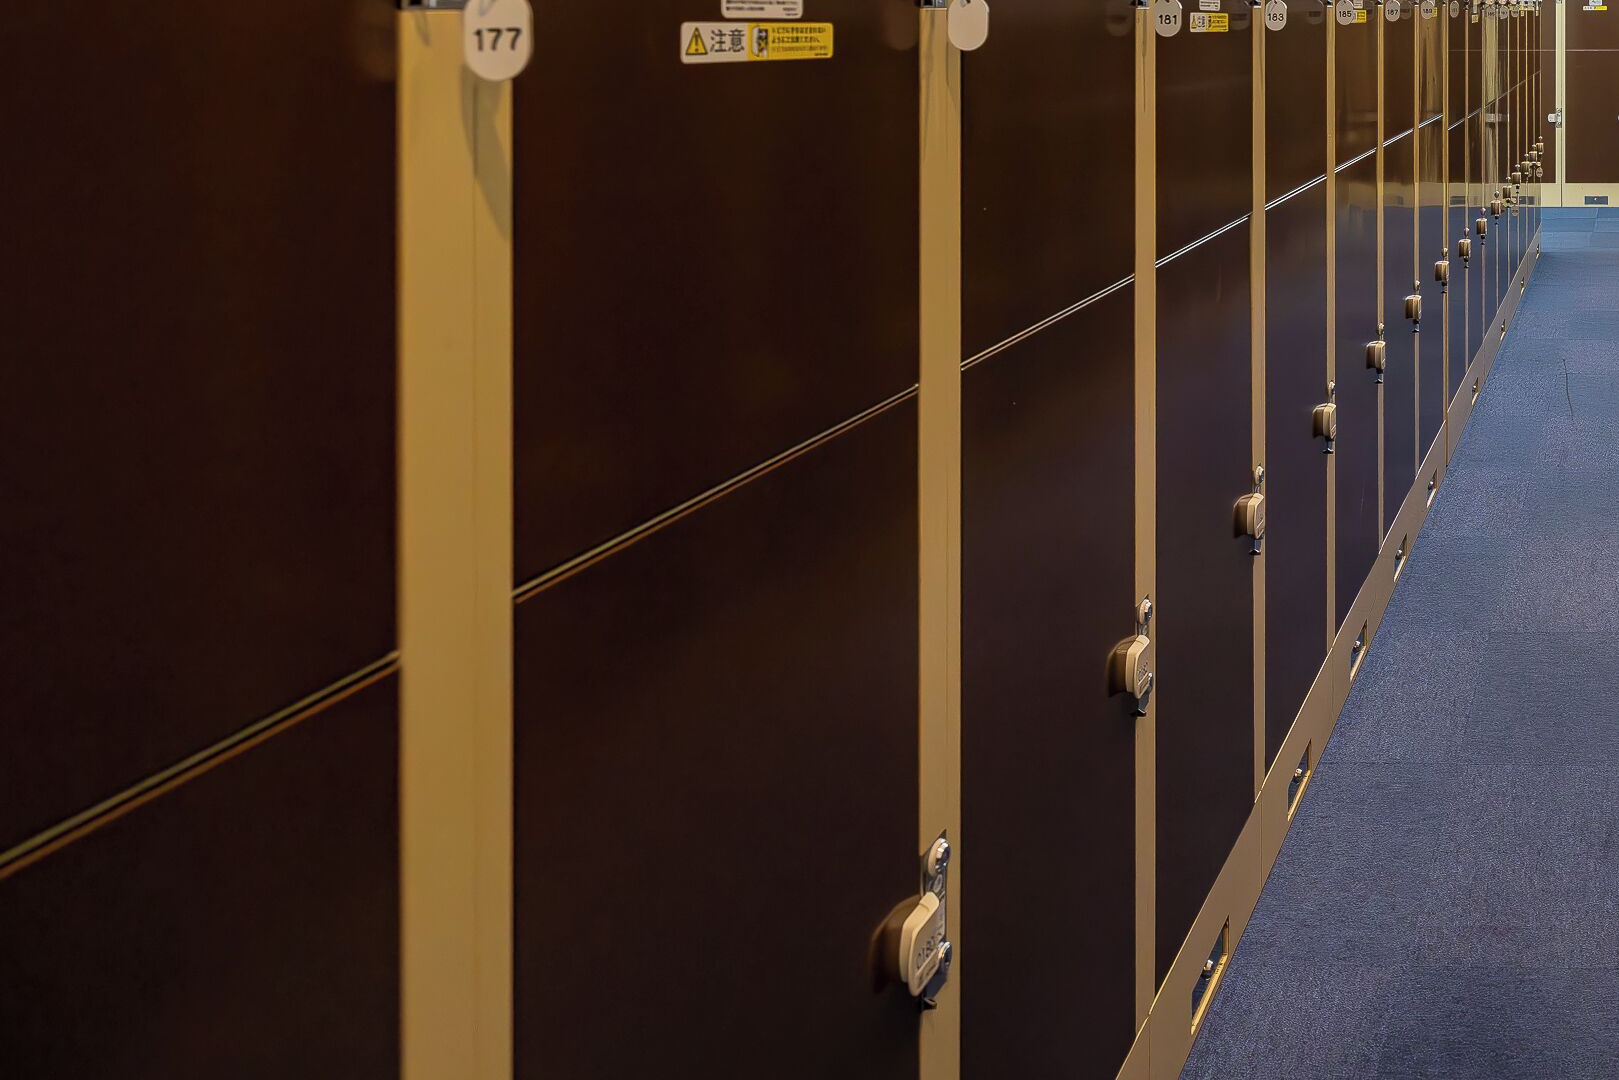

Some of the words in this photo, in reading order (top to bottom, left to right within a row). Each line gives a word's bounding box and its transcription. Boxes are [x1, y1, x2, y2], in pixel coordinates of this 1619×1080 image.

[1158, 14, 1178, 25] 181
[1267, 13, 1284, 22] 183
[1338, 10, 1352, 18] 185
[473, 27, 523, 52] 177
[709, 28, 745, 53] 注意
